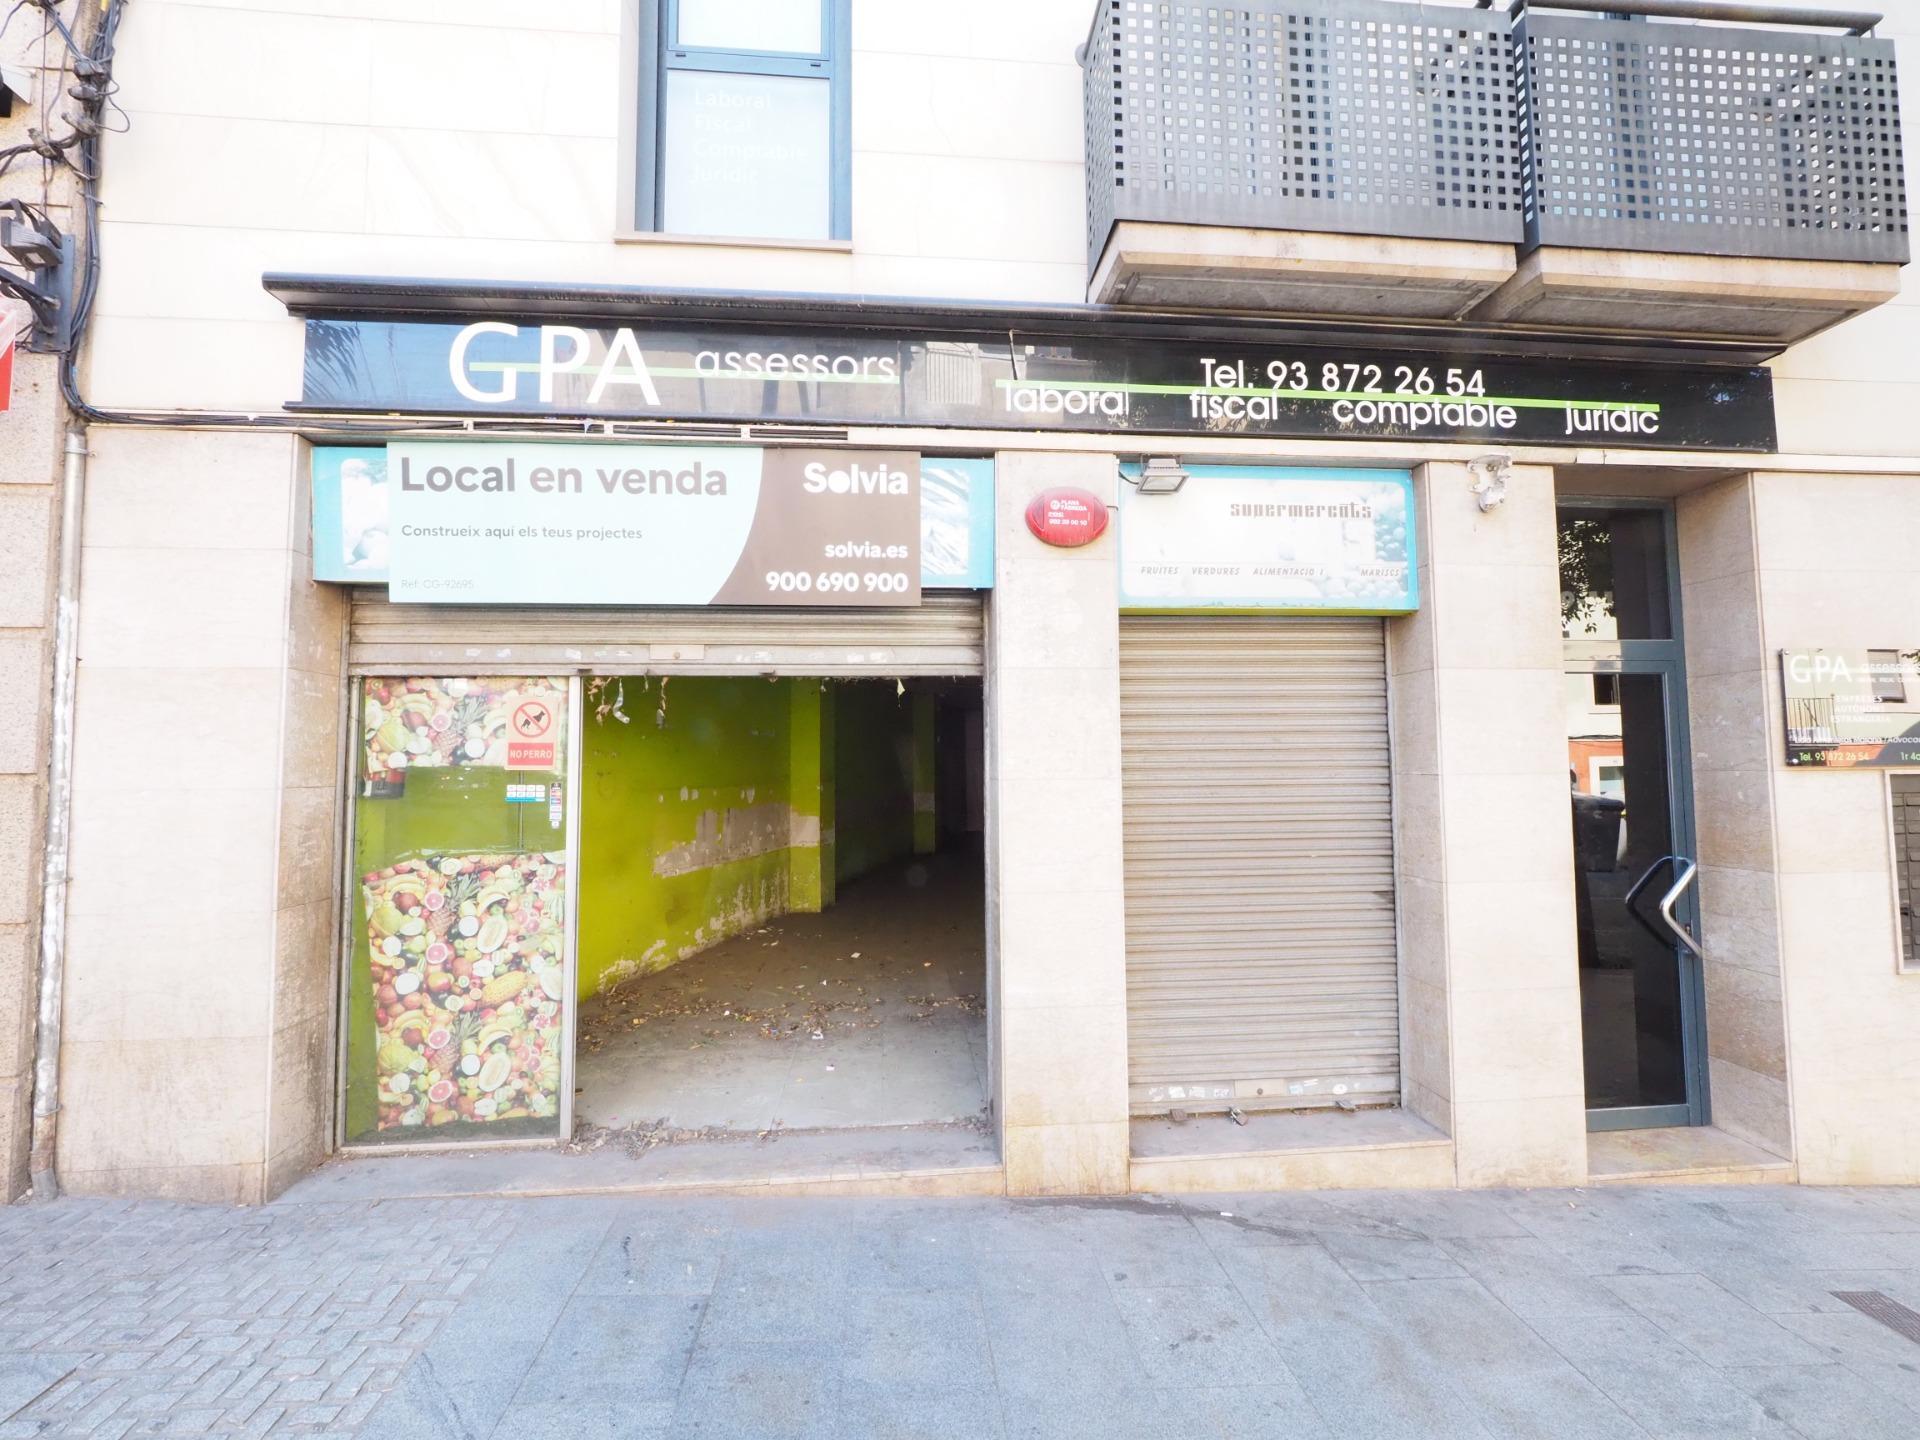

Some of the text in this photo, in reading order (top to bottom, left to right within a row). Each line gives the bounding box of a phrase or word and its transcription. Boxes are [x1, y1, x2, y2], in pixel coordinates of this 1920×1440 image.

[694, 87, 771, 110] Laboral
[449, 321, 896, 406] GPA assessors
[1200, 358, 1486, 398] Tel. 93 872 26 54
[1004, 385, 1130, 415] laboral
[1189, 389, 1279, 420] fiscal
[1332, 398, 1518, 430] comptable
[400, 456, 728, 496] Local en venda
[803, 462, 909, 495] Solvia
[401, 524, 481, 538] Construeix
[518, 525, 539, 538] els
[542, 525, 573, 539] teus
[576, 527, 643, 541] projectes
[824, 541, 909, 559] solvia.es
[765, 571, 909, 593] 900 690 900
[1140, 566, 1179, 576] FRUITES
[1191, 567, 1241, 577] VERDURES
[1360, 568, 1401, 578] MARISCS
[1789, 655, 1853, 684] GPA
[510, 749, 553, 759] NO PERRO
[1800, 752, 1812, 761] Tel.
[1815, 752, 1825, 761] 93
[1846, 752, 1856, 761] 26
